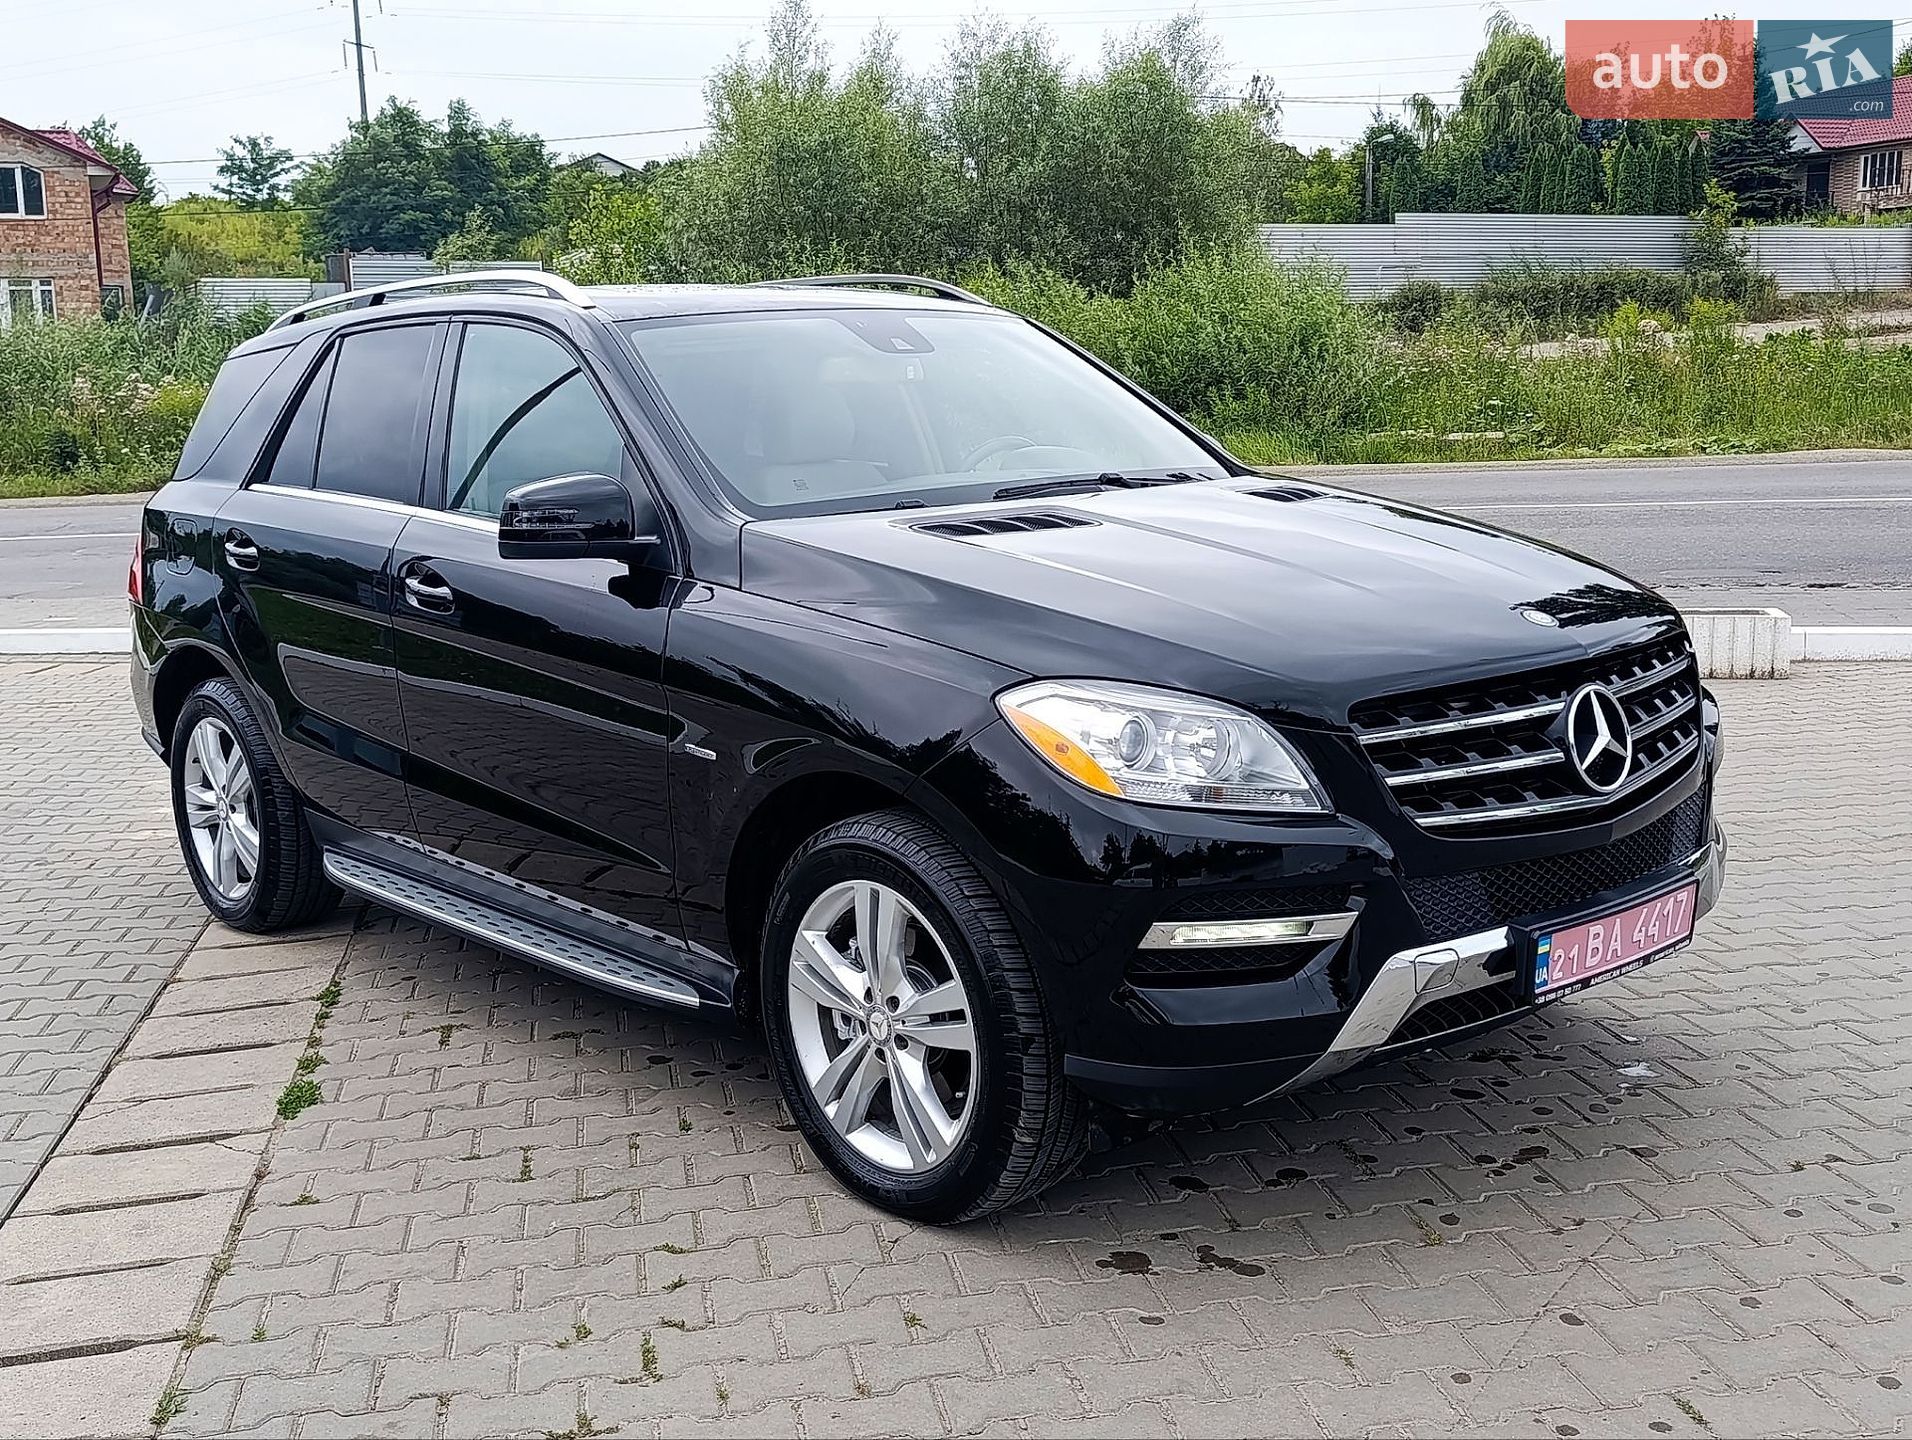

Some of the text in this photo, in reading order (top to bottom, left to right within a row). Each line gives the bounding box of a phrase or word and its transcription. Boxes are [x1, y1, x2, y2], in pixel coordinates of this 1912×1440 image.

[1552, 890, 1689, 980] 21 BA 4417
[1535, 966, 1549, 984] UA
[1589, 966, 1621, 986] AMERICAN
